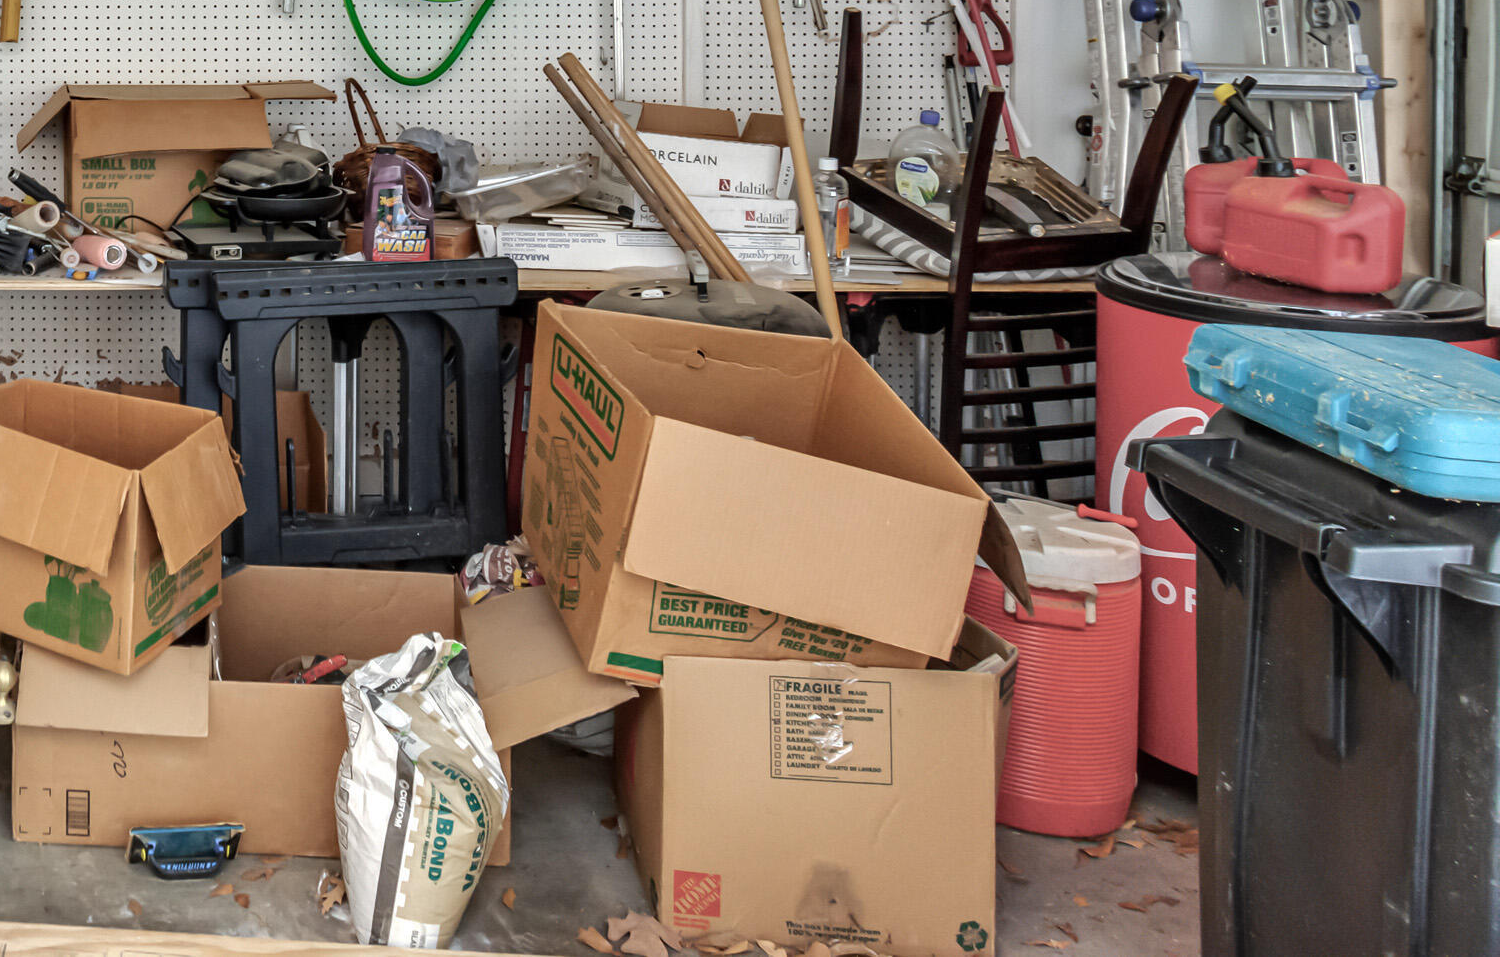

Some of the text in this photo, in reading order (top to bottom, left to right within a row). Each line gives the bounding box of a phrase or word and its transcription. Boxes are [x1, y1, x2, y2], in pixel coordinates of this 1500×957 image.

[81, 158, 156, 170] SMALL BOX
[650, 148, 718, 166] ORCELAIN
[734, 179, 774, 196] daltile
[756, 210, 789, 225] daltile
[401, 230, 426, 240] CAR
[377, 238, 427, 253] WASH
[556, 346, 616, 433] U-HAUL
[659, 597, 750, 619] BEST PRICE
[658, 613, 748, 634] GUARANTEED
[778, 637, 805, 652] FREE
[781, 627, 805, 640] Give
[851, 640, 863, 653] in
[786, 681, 842, 695] FRAGILE
[785, 694, 822, 702] BEDROOM
[786, 736, 817, 744] BASEM
[786, 753, 805, 761] ATTIC
[786, 761, 820, 769] LAUNDRY
[394, 790, 409, 828] CUSTOM
[786, 920, 803, 930] This
[832, 925, 858, 935] made
[787, 926, 812, 936] 100%
